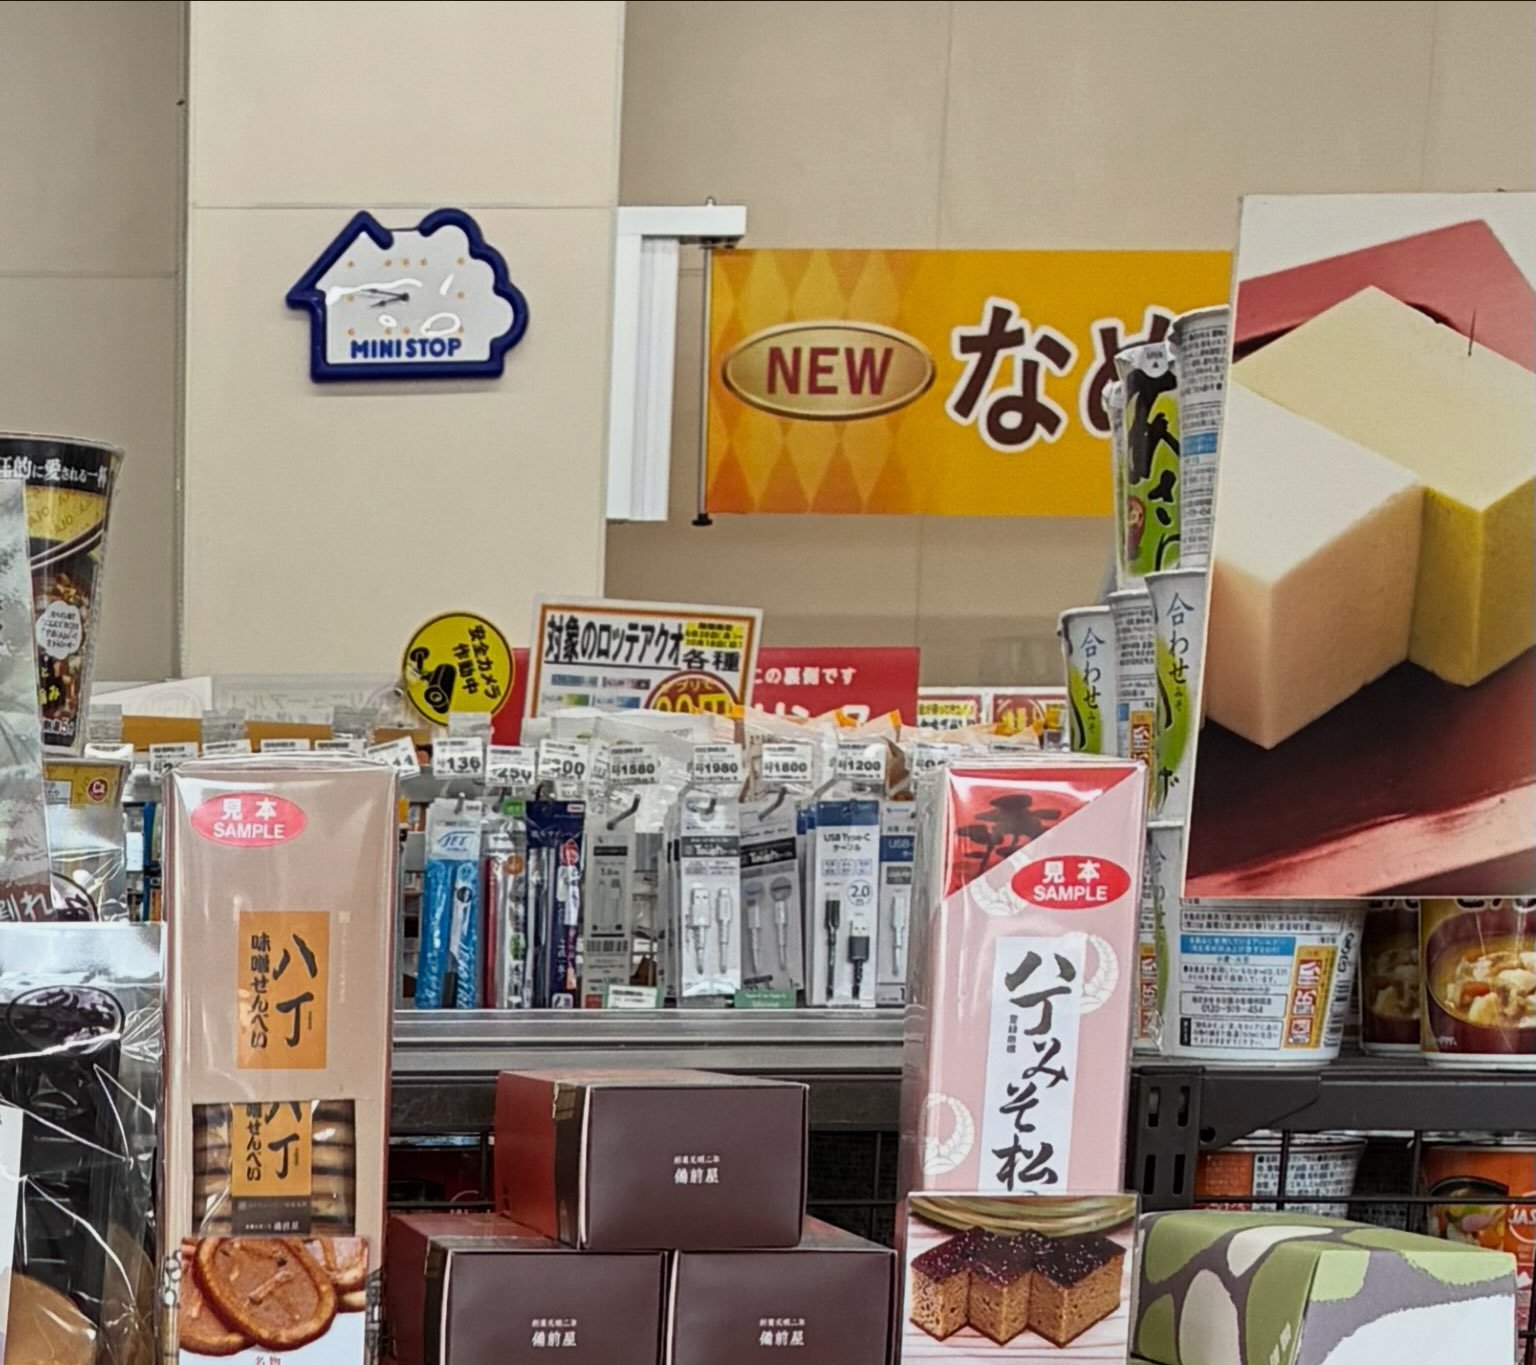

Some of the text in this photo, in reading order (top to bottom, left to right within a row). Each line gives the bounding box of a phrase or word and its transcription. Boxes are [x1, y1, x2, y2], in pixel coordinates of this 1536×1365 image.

[349, 336, 463, 361] MINISTOP
[766, 345, 894, 395] NEW
[544, 614, 684, 665] 対象のロッテアクオ
[681, 648, 741, 672] 各種
[468, 624, 501, 700] 安全カメラ
[221, 797, 278, 820] 見本
[213, 821, 286, 840] SAMPLE
[1041, 859, 1102, 884] 見本
[1032, 884, 1109, 902] SAMPLE
[249, 932, 271, 1049] 味噌せんべい
[272, 932, 319, 1049] 八丁
[992, 950, 1077, 1195] 八丁みそ松
[674, 1167, 720, 1185] 備前屋
[532, 1331, 577, 1348] 備前屋
[759, 1330, 805, 1347] 備前屋
